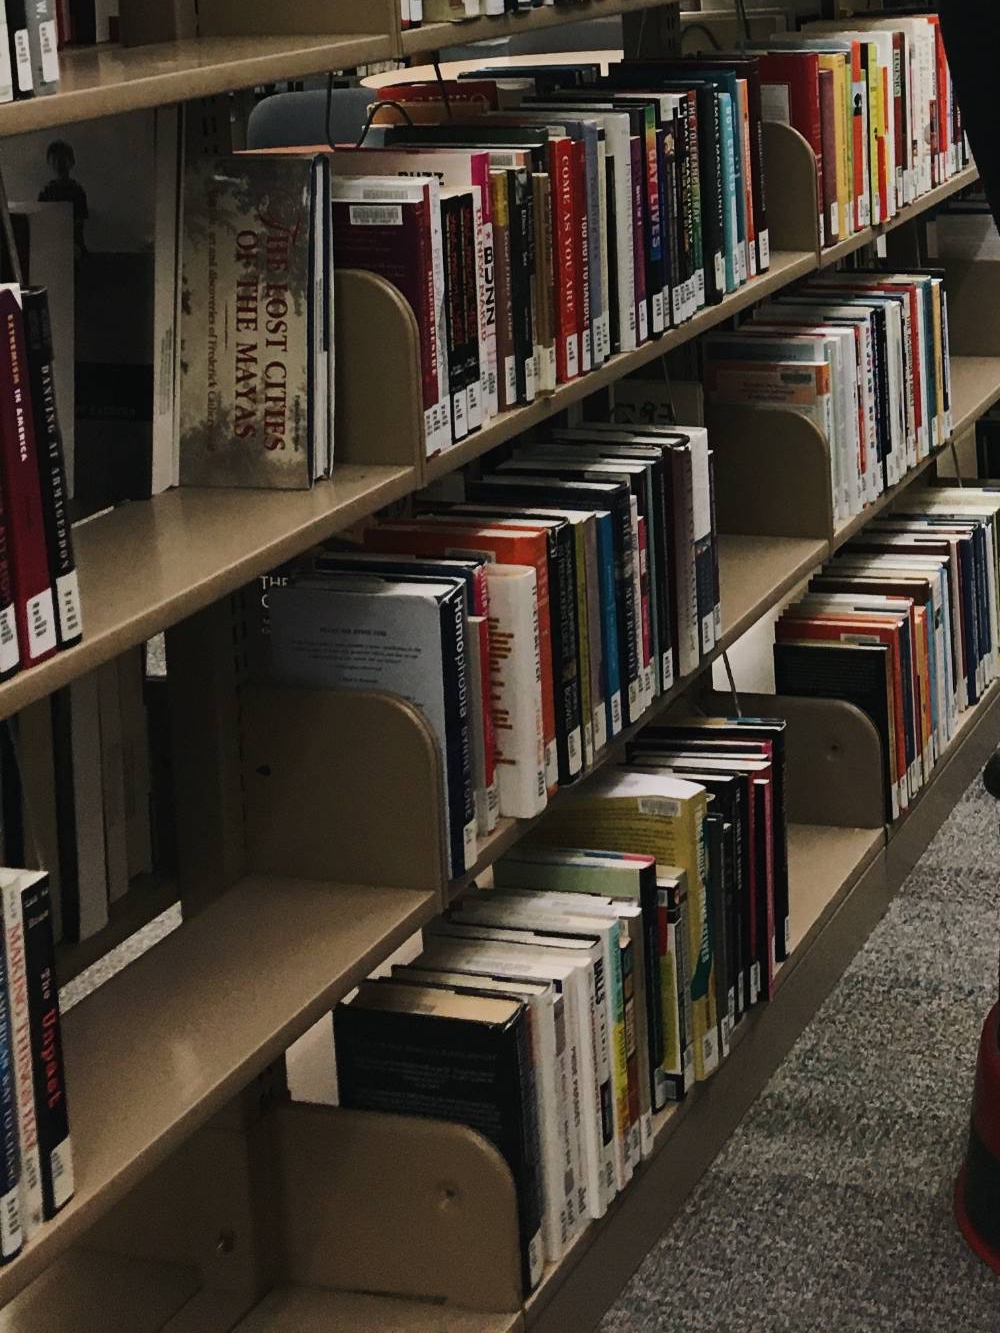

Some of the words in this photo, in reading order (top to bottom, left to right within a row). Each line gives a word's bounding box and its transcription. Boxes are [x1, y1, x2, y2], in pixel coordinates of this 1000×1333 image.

[893, 52, 902, 96] EUGENICS
[683, 103, 691, 151] FEMALE
[688, 100, 697, 122] THE
[712, 91, 720, 138] FEMALE
[725, 107, 733, 132] BOY
[561, 155, 572, 204] COME
[648, 149, 659, 184] GAY
[689, 125, 699, 189] TOLERANCE
[727, 139, 736, 192] ERASED
[685, 157, 694, 245] MASCULINITY
[691, 195, 701, 224] TRAP
[715, 144, 724, 228] MASCULINITY
[563, 211, 573, 231] AS
[650, 192, 661, 249] LIVES
[234, 230, 259, 269] OF
[564, 236, 574, 273] YOU
[207, 269, 219, 325] discoveries
[235, 278, 258, 332] THE
[484, 247, 495, 326] BUZZ
[565, 278, 575, 314] ARE
[583, 283, 592, 329] HANDLE
[265, 282, 289, 352] LOST
[479, 284, 487, 342] NAKED
[7, 314, 20, 385] EXTREMISM
[207, 341, 219, 388] Frederick
[430, 327, 438, 377] DESIRE
[12, 387, 22, 403] IN
[40, 365, 58, 434] DANCING
[233, 342, 258, 439] MAYAS
[263, 361, 288, 452] CITIES
[15, 407, 28, 463] AMERICA
[48, 441, 60, 459] AT
[50, 466, 70, 571] ARMAGEDDON
[453, 595, 468, 718] Homophobia
[625, 586, 636, 679] METROPOLI
[461, 726, 471, 771] BYRNE
[463, 780, 473, 821] FONE
[8, 923, 26, 1018] MAKING
[38, 967, 52, 1000] The
[593, 957, 606, 1005] BALLS
[40, 1007, 63, 1110] Unpast
[2, 1073, 13, 1104] WAY
